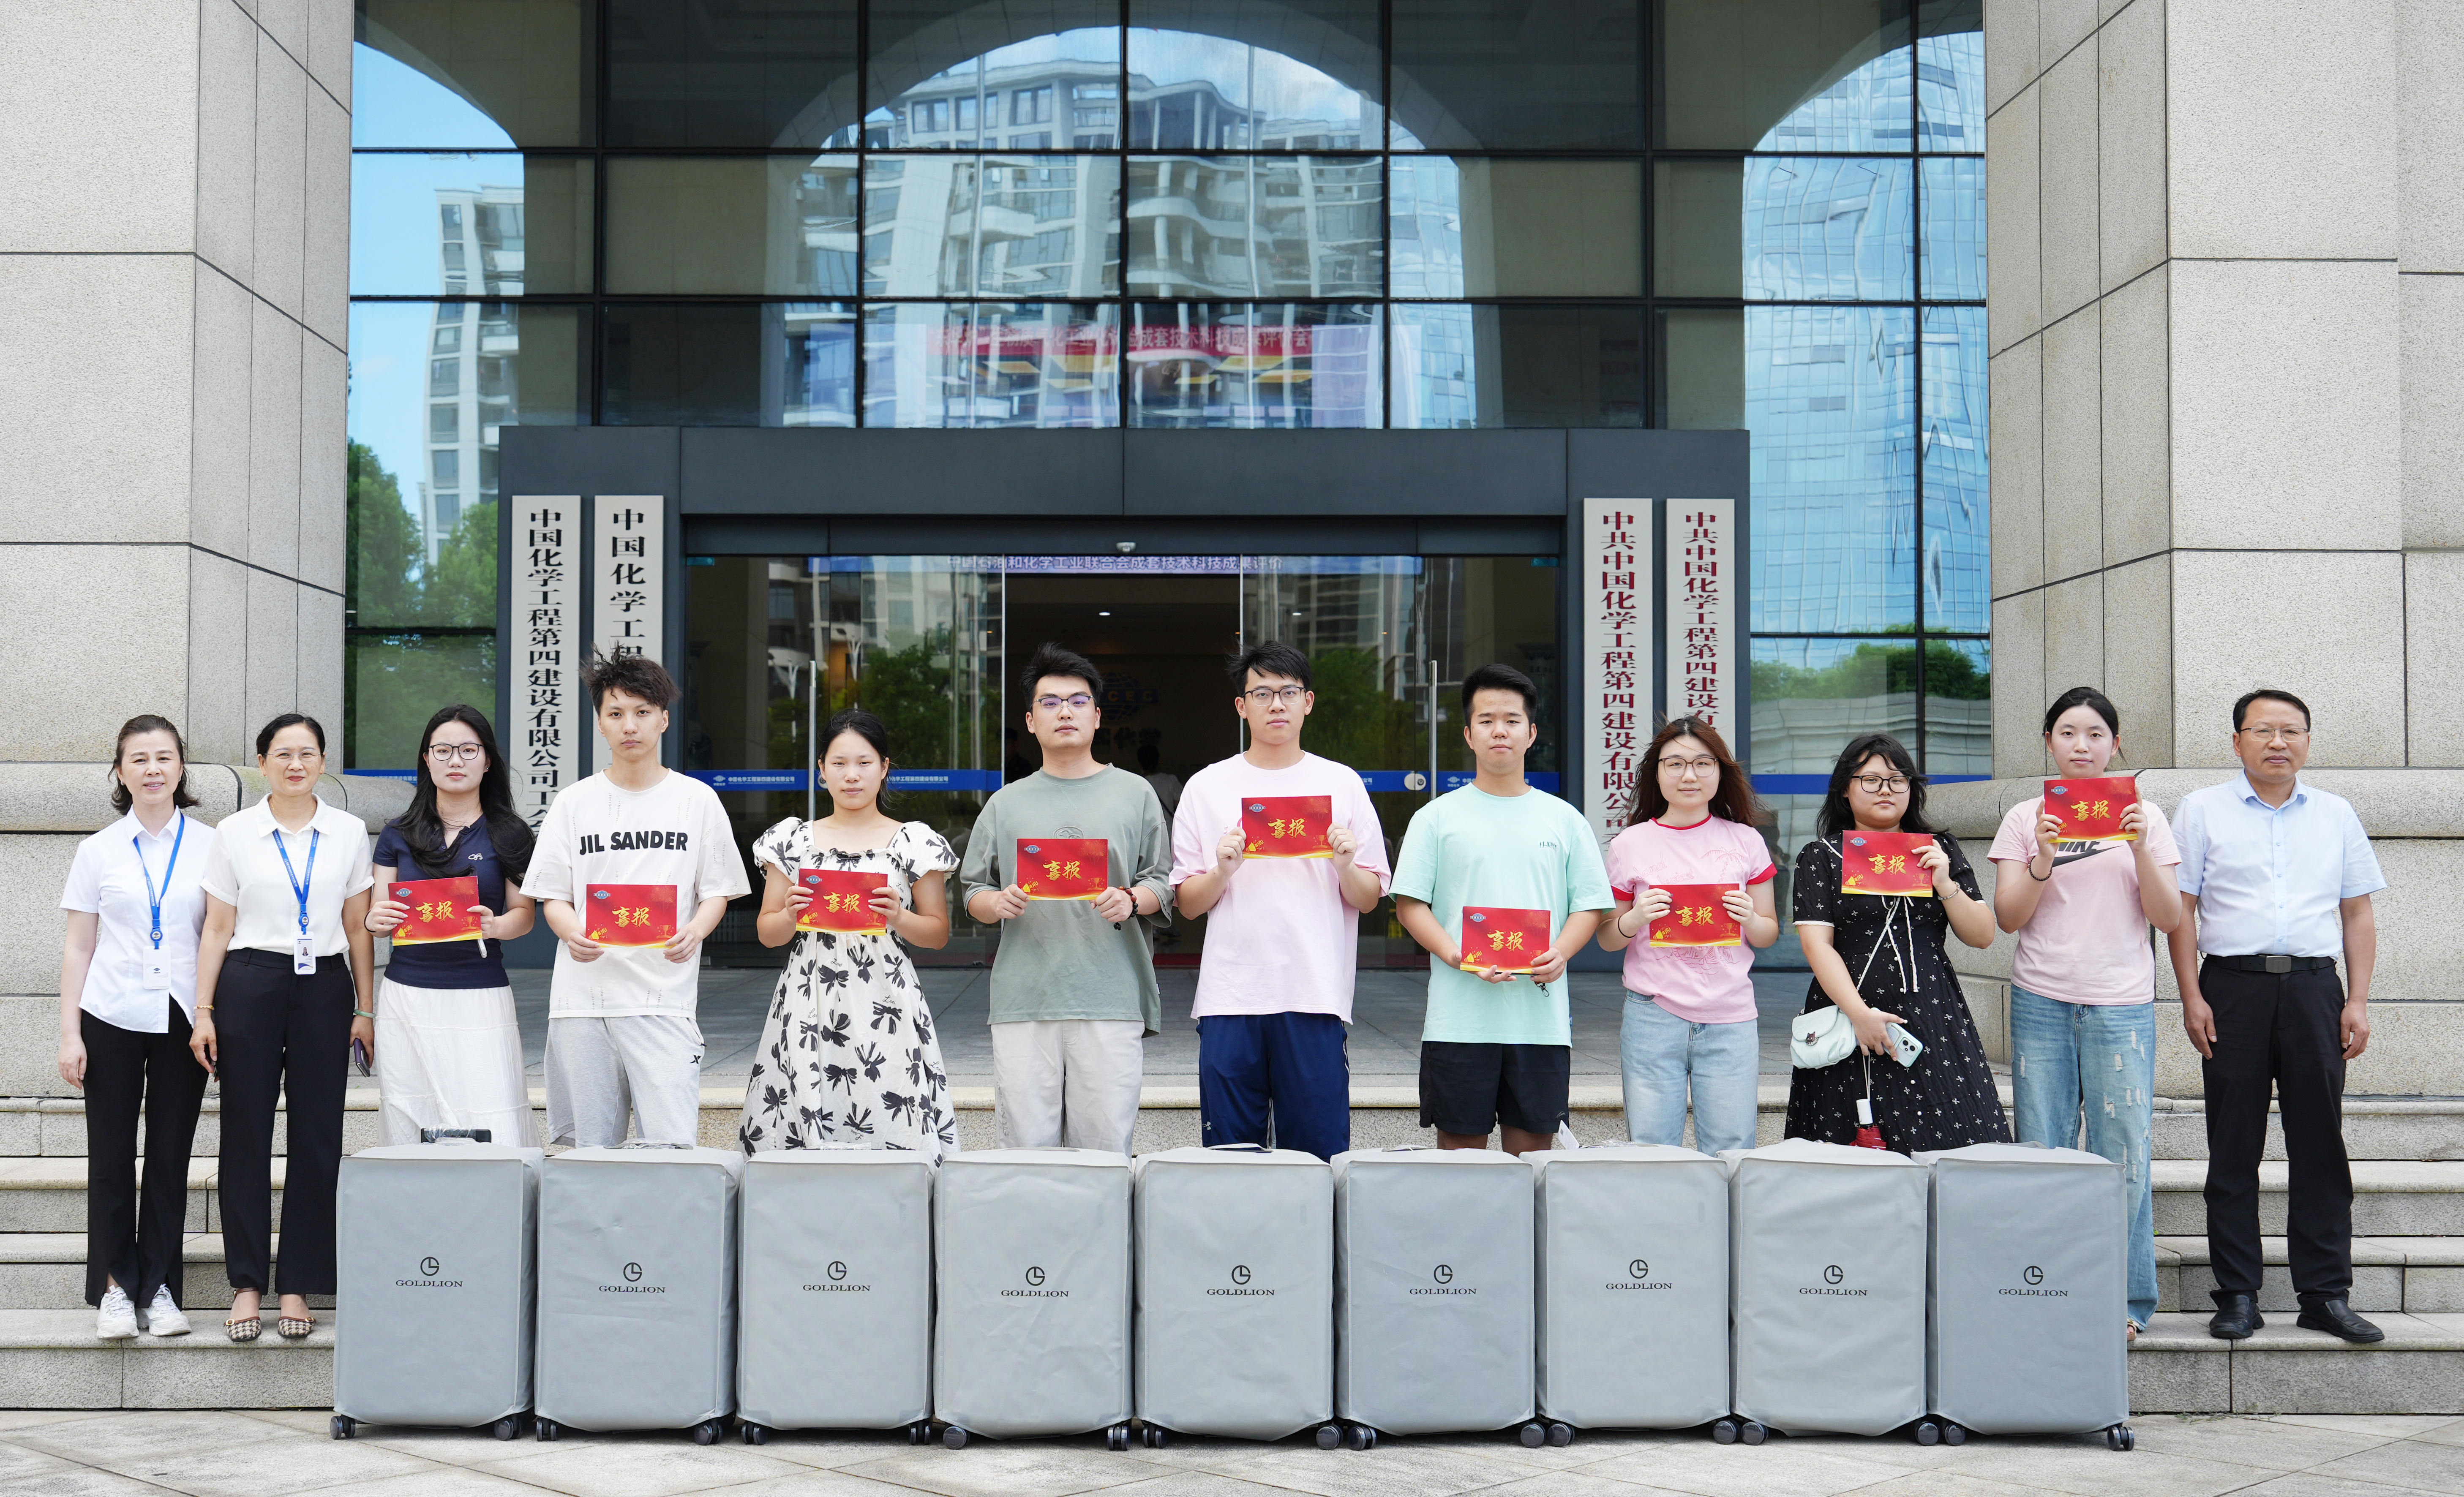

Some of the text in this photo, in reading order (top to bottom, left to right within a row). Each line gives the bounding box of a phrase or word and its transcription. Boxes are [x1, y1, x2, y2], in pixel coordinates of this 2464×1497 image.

[1682, 512, 1719, 730] 中共中国化学工程第四建设有
[526, 508, 564, 839] 中国化学工程第四建设有限公司工会
[1107, 690, 1153, 702] CEC
[2070, 800, 2111, 822] 喜报
[1267, 818, 1307, 839] 喜报
[580, 830, 688, 855] JIL SANDER
[1042, 860, 1082, 881] 喜报
[1868, 853, 1907, 875] 喜报
[415, 900, 455, 923] 喜报
[823, 892, 861, 914] 喜报
[611, 906, 651, 928] 喜报
[1674, 906, 1715, 927] 喜报
[1487, 929, 1524, 952] 喜报
[599, 1285, 666, 1293] GOLDLION
[1799, 1288, 1868, 1296] GOLDLION
[1998, 1288, 2069, 1296] GOLDLION
